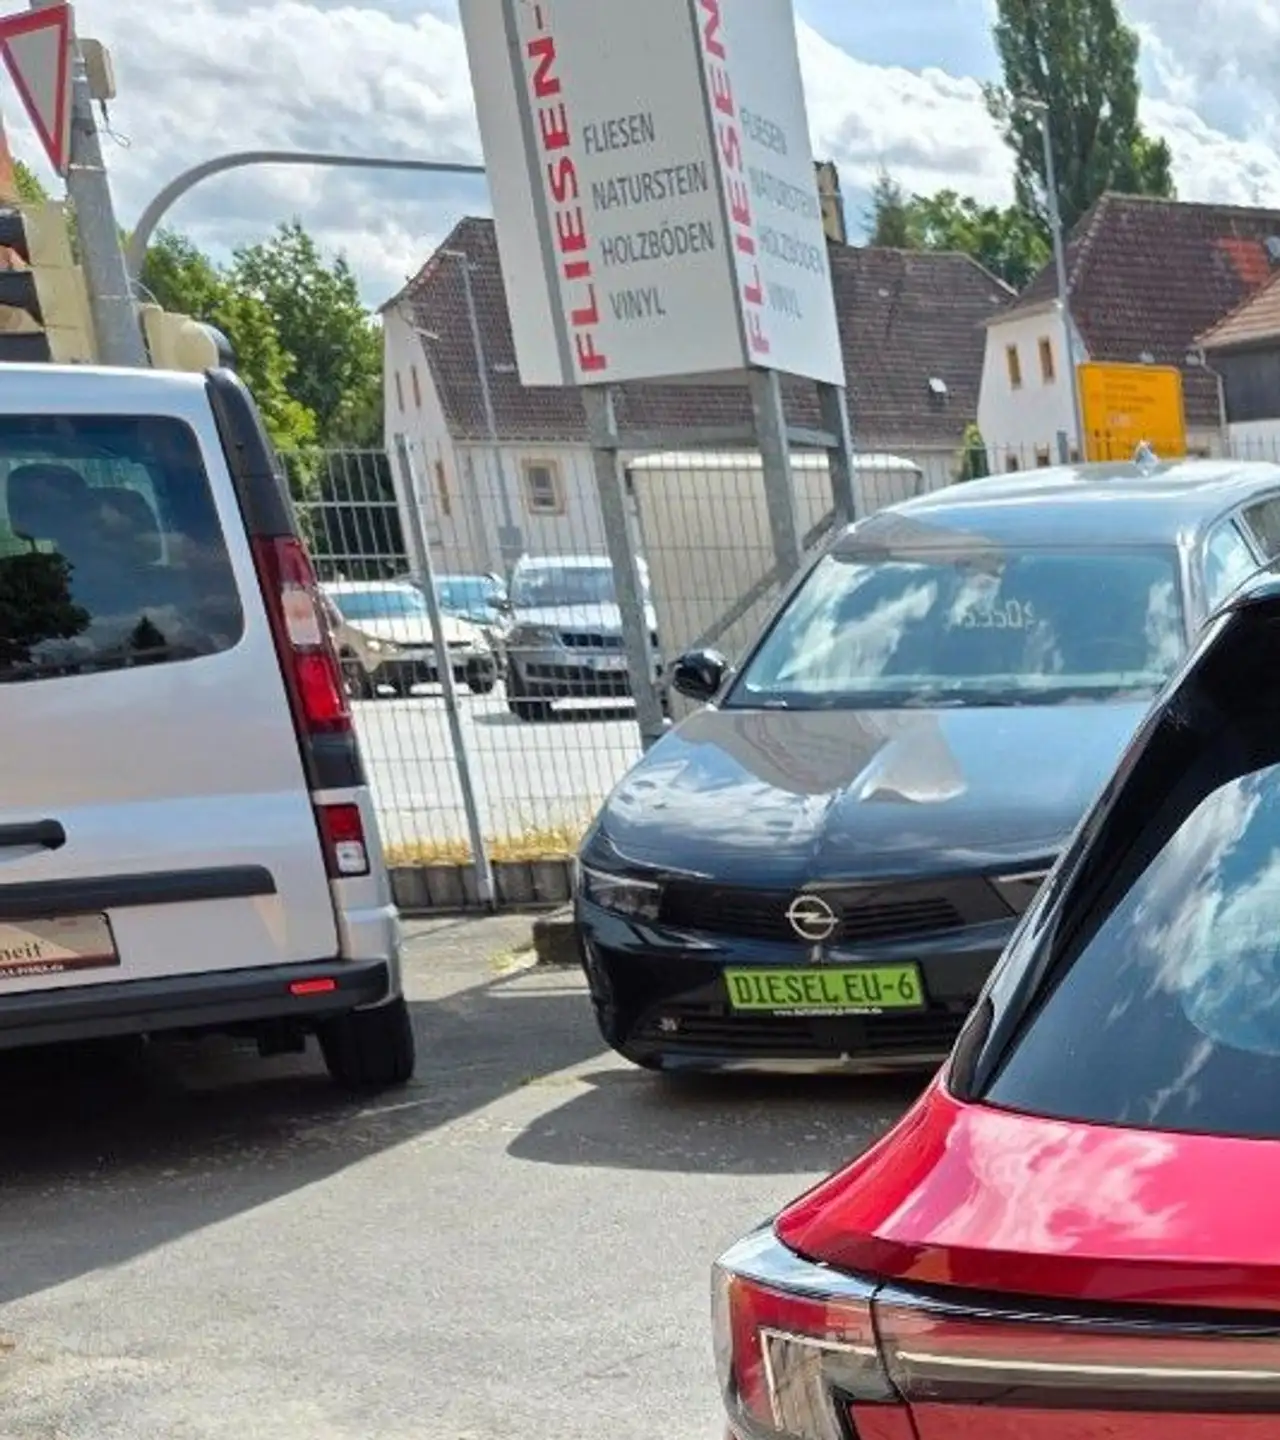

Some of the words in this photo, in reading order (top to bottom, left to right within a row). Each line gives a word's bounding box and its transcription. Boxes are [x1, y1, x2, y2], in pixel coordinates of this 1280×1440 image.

[583, 112, 655, 154] FLIESEN
[524, 2, 607, 372] FLIESEN-
[591, 161, 709, 211] NATURSTEIN
[701, 0, 770, 354] FLIESEN
[600, 217, 715, 266] HOLZBÖDEN
[608, 287, 666, 320] VINYL
[733, 974, 839, 1004] DIESEL
[843, 973, 914, 1002] EU-6
